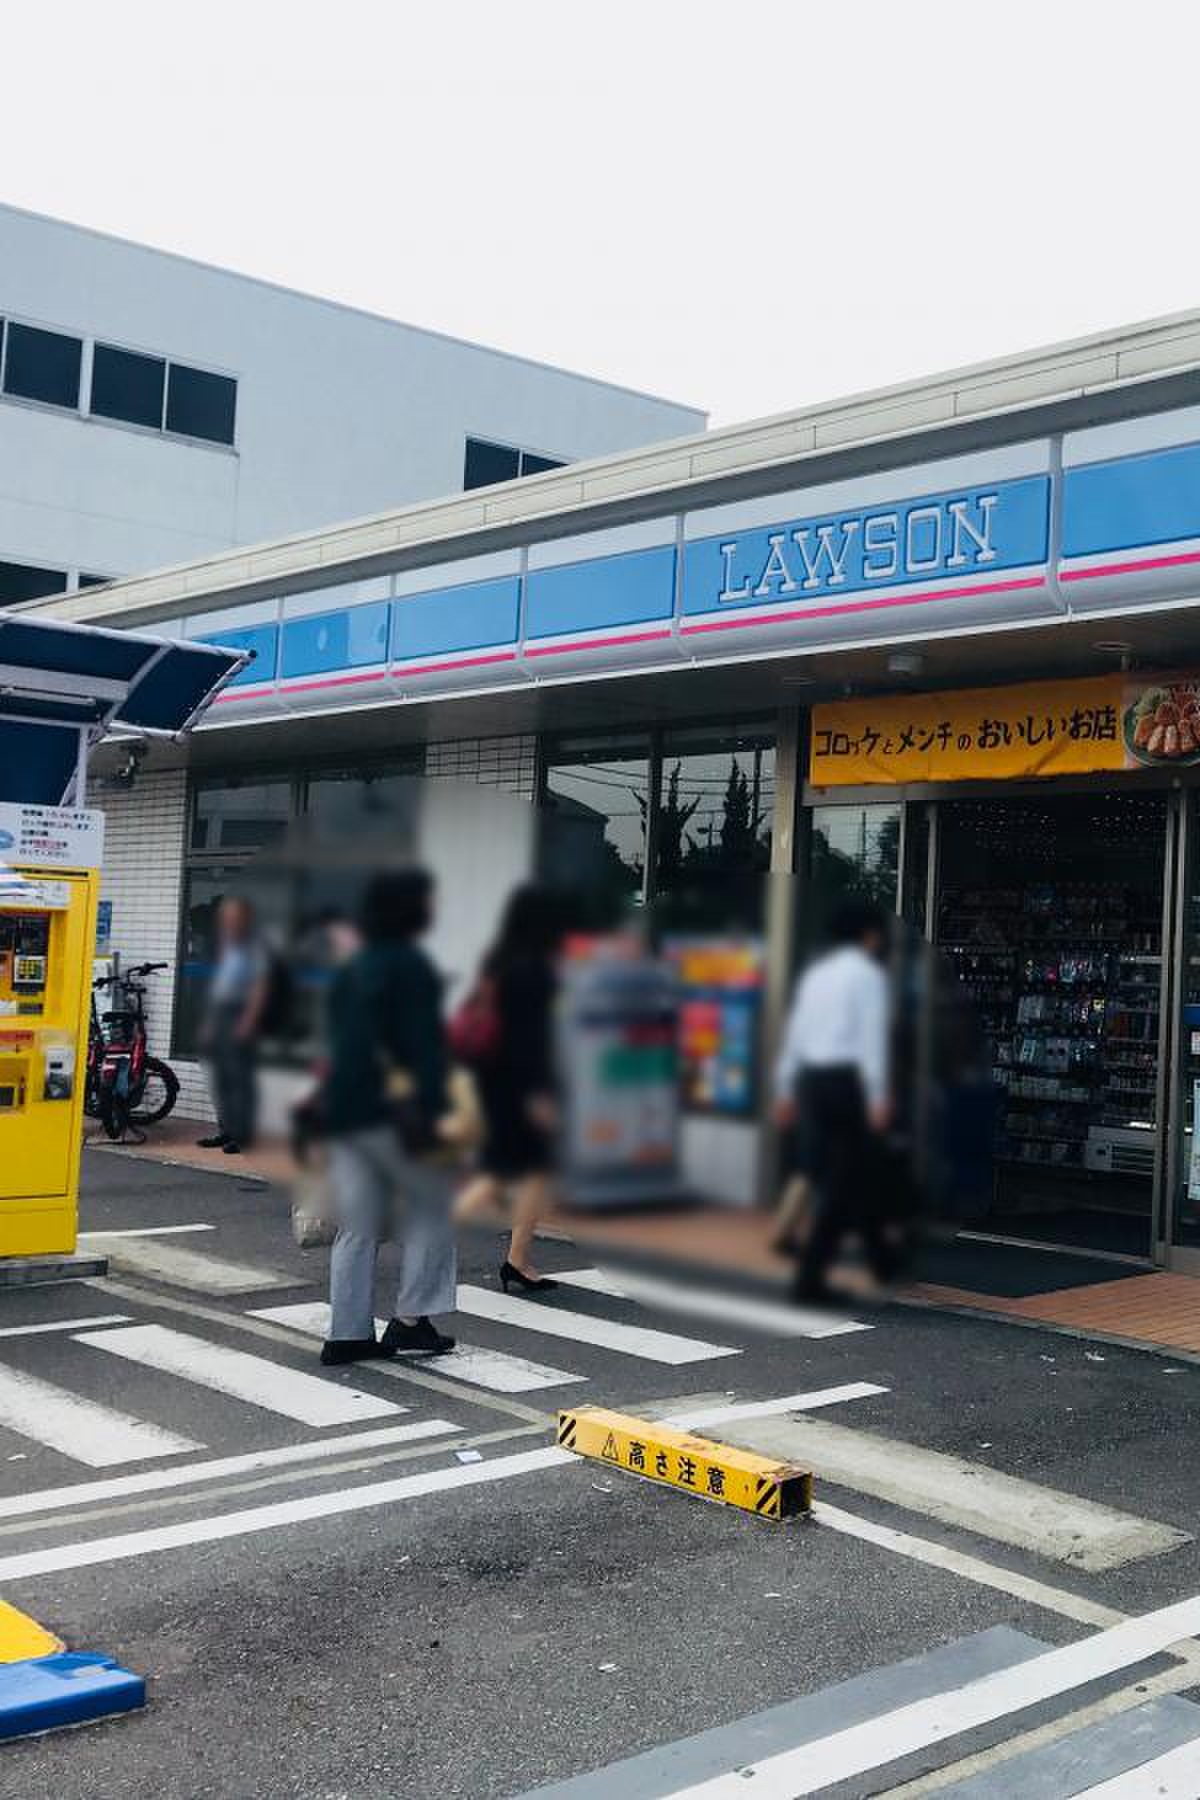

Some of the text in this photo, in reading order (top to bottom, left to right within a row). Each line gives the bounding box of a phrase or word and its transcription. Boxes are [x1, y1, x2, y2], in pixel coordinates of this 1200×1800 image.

[719, 495, 998, 601] LAWSON
[814, 704, 1117, 757] コロッケとメンチのおいしいお店
[629, 1440, 727, 1497] 高さ注意
